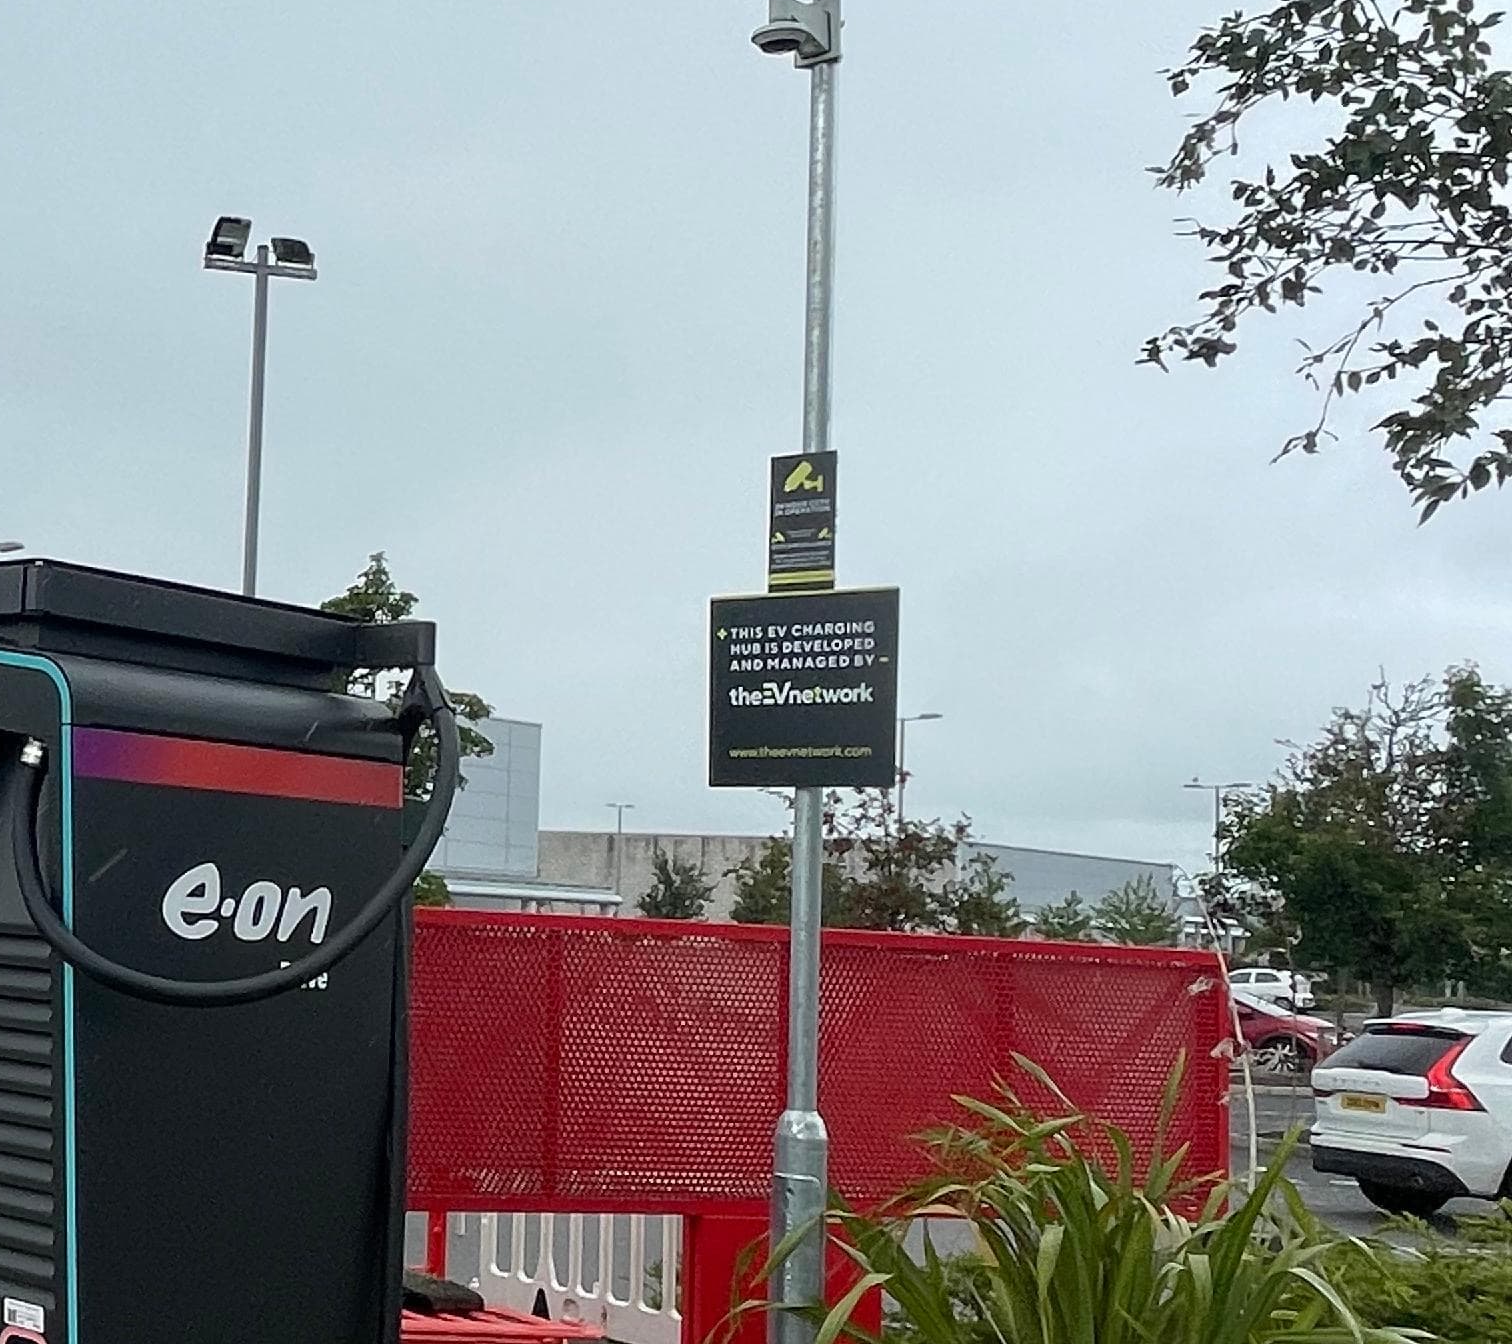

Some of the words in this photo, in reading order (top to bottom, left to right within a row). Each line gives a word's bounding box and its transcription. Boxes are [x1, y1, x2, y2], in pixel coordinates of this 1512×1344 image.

[731, 627, 763, 639] THIS
[768, 625, 788, 638] EV
[791, 621, 875, 636] CHARGING
[730, 642, 761, 656] HUB
[764, 642, 778, 654] IS
[782, 638, 875, 653] DEVELOPED
[729, 658, 764, 672] AND
[767, 656, 850, 670] MANAGED
[854, 654, 875, 667] BY
